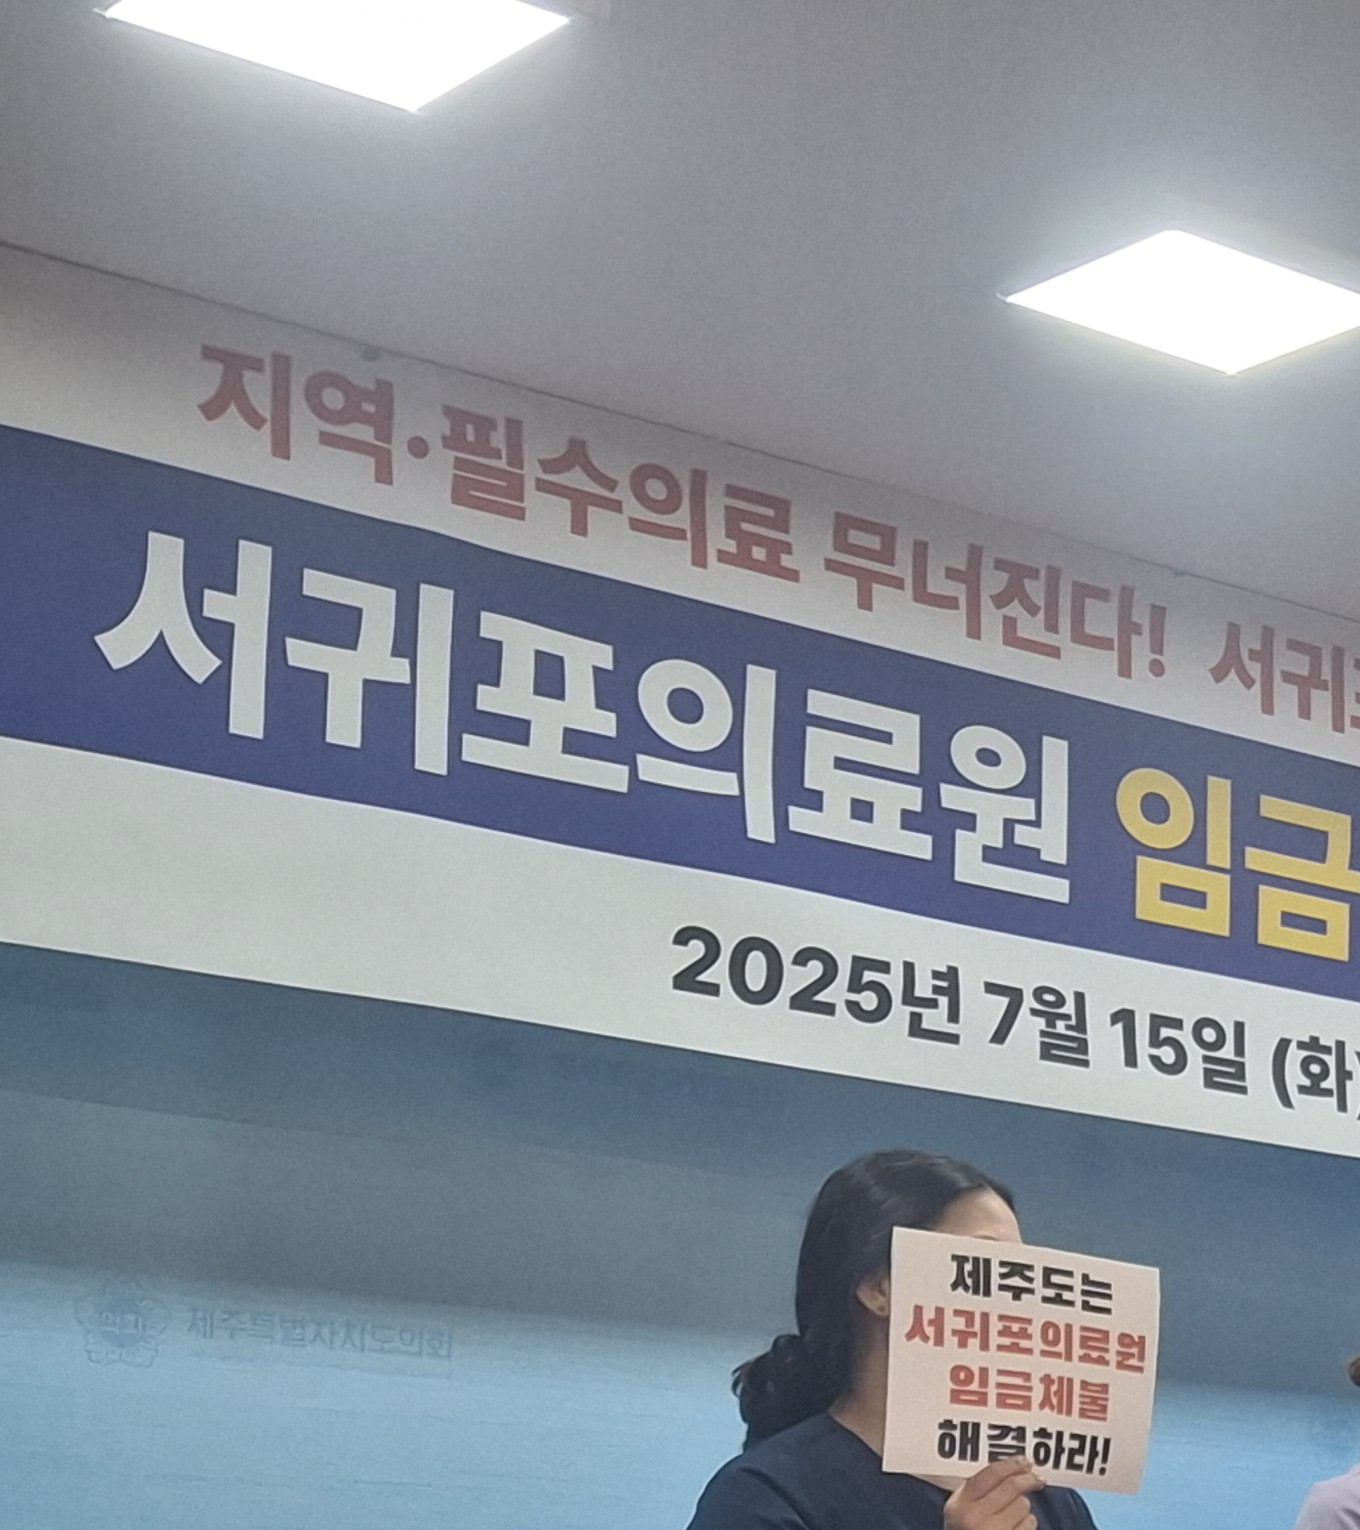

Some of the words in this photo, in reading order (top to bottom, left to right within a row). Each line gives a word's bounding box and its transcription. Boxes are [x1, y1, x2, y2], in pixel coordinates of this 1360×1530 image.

[199, 342, 801, 584] 지역·필수의료
[823, 510, 1167, 680] 무너진다!
[94, 530, 1071, 904] 서귀포의료원
[670, 924, 961, 1046] 2025년
[982, 980, 1091, 1069] 7월
[1109, 1007, 1249, 1096] 15일
[949, 1254, 1113, 1316] 제주도는
[904, 1304, 1147, 1375] 서귀포의료원
[949, 1364, 1110, 1422] 임금체불
[936, 1418, 1112, 1477] 해결하라!
